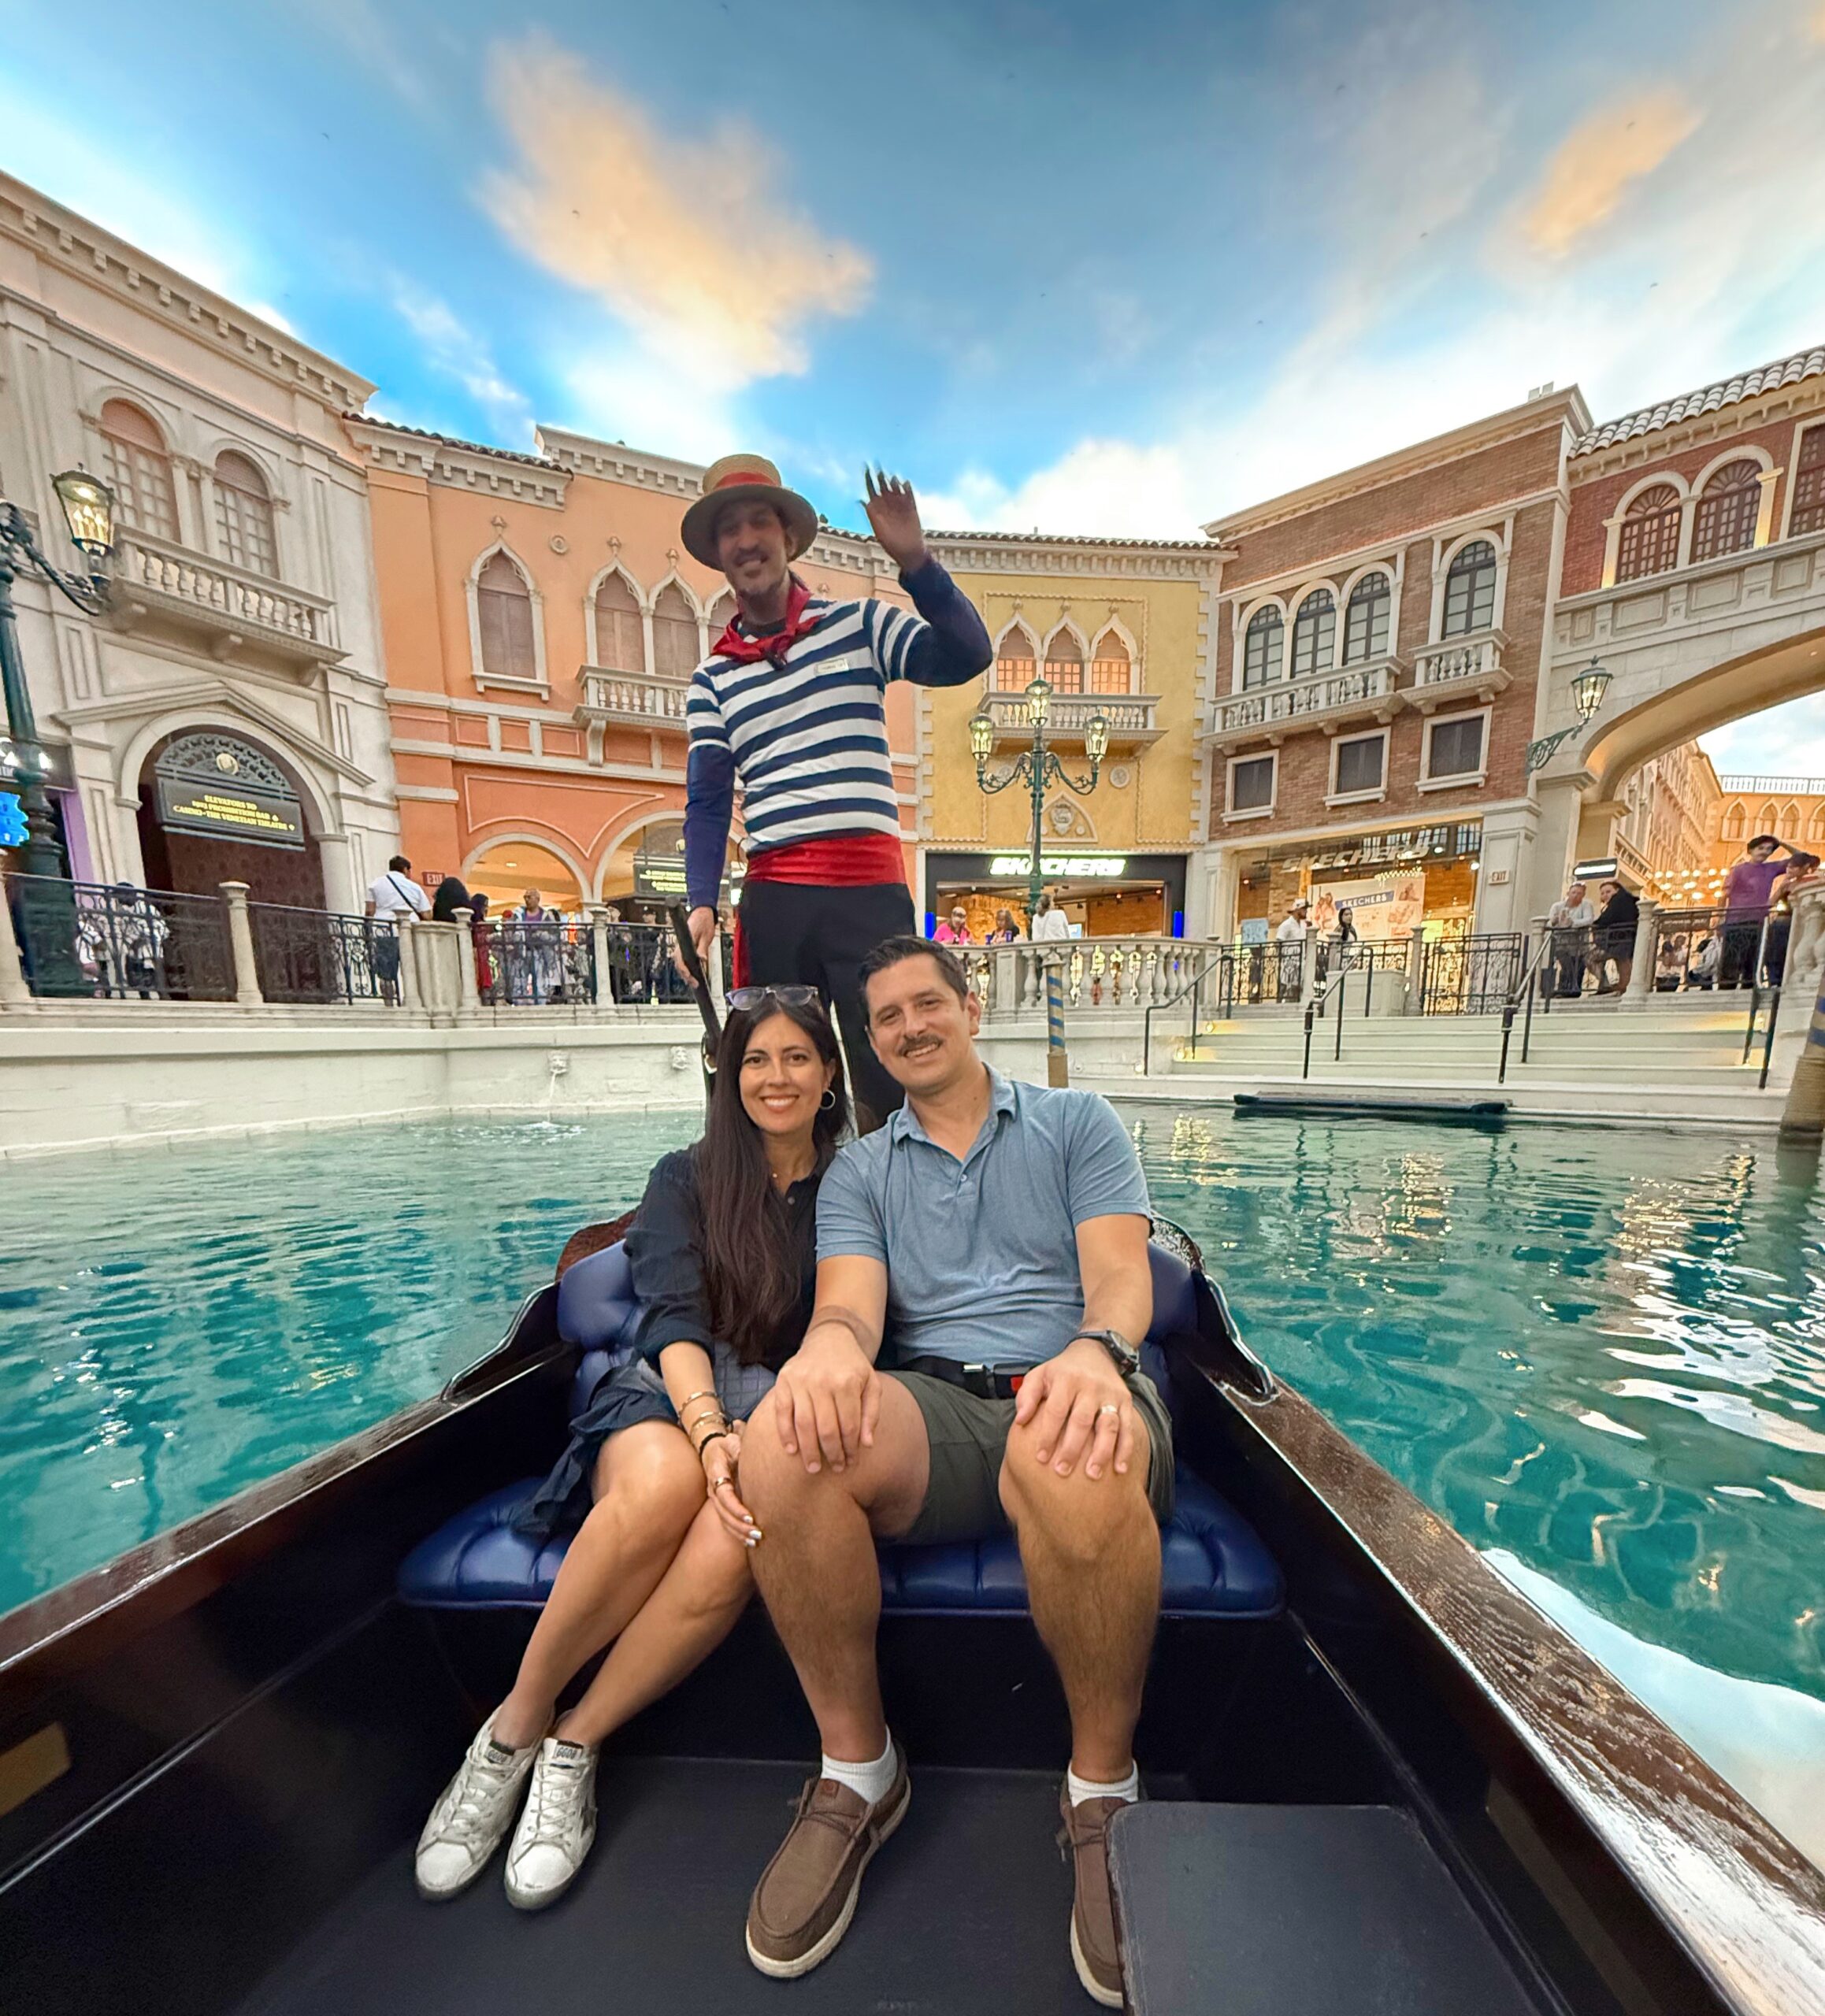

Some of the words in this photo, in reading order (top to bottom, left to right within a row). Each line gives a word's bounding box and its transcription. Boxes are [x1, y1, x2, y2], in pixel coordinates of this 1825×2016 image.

[205, 795, 246, 808] ELEVATORS
[173, 805, 203, 816] CASINO
[221, 813, 256, 825] VENETIAN
[209, 803, 255, 817] PROHIBITION
[1280, 843, 1430, 873] SKECHERS
[1492, 869, 1507, 882] EXIT
[1341, 893, 1388, 908] SKECHERS
